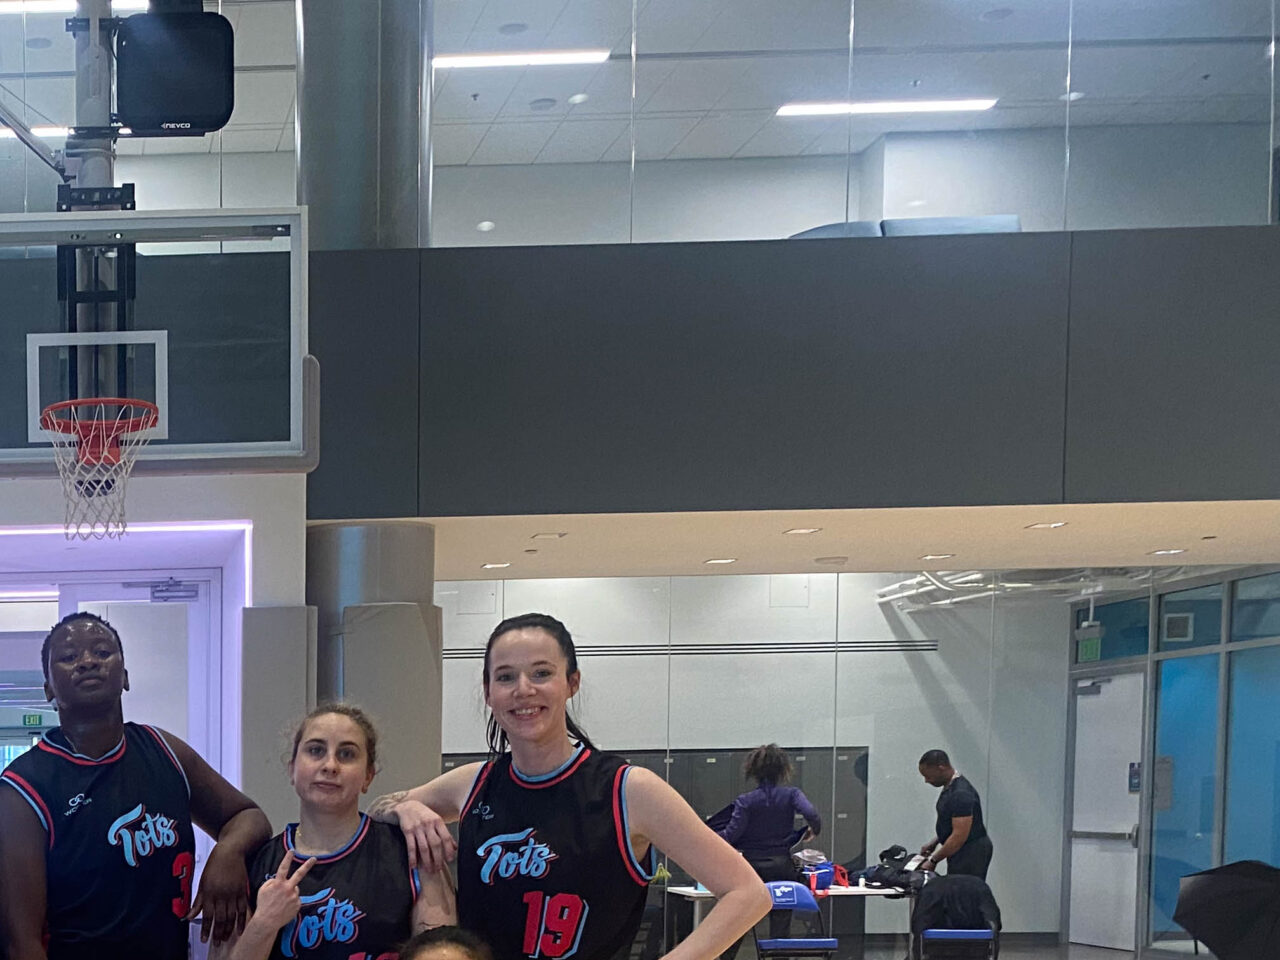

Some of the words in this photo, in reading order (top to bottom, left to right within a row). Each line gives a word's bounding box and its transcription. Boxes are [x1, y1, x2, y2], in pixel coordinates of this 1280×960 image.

[107, 803, 177, 868] Tots
[476, 827, 560, 886] Tots
[281, 887, 367, 959] Tots
[522, 890, 590, 960] 19
